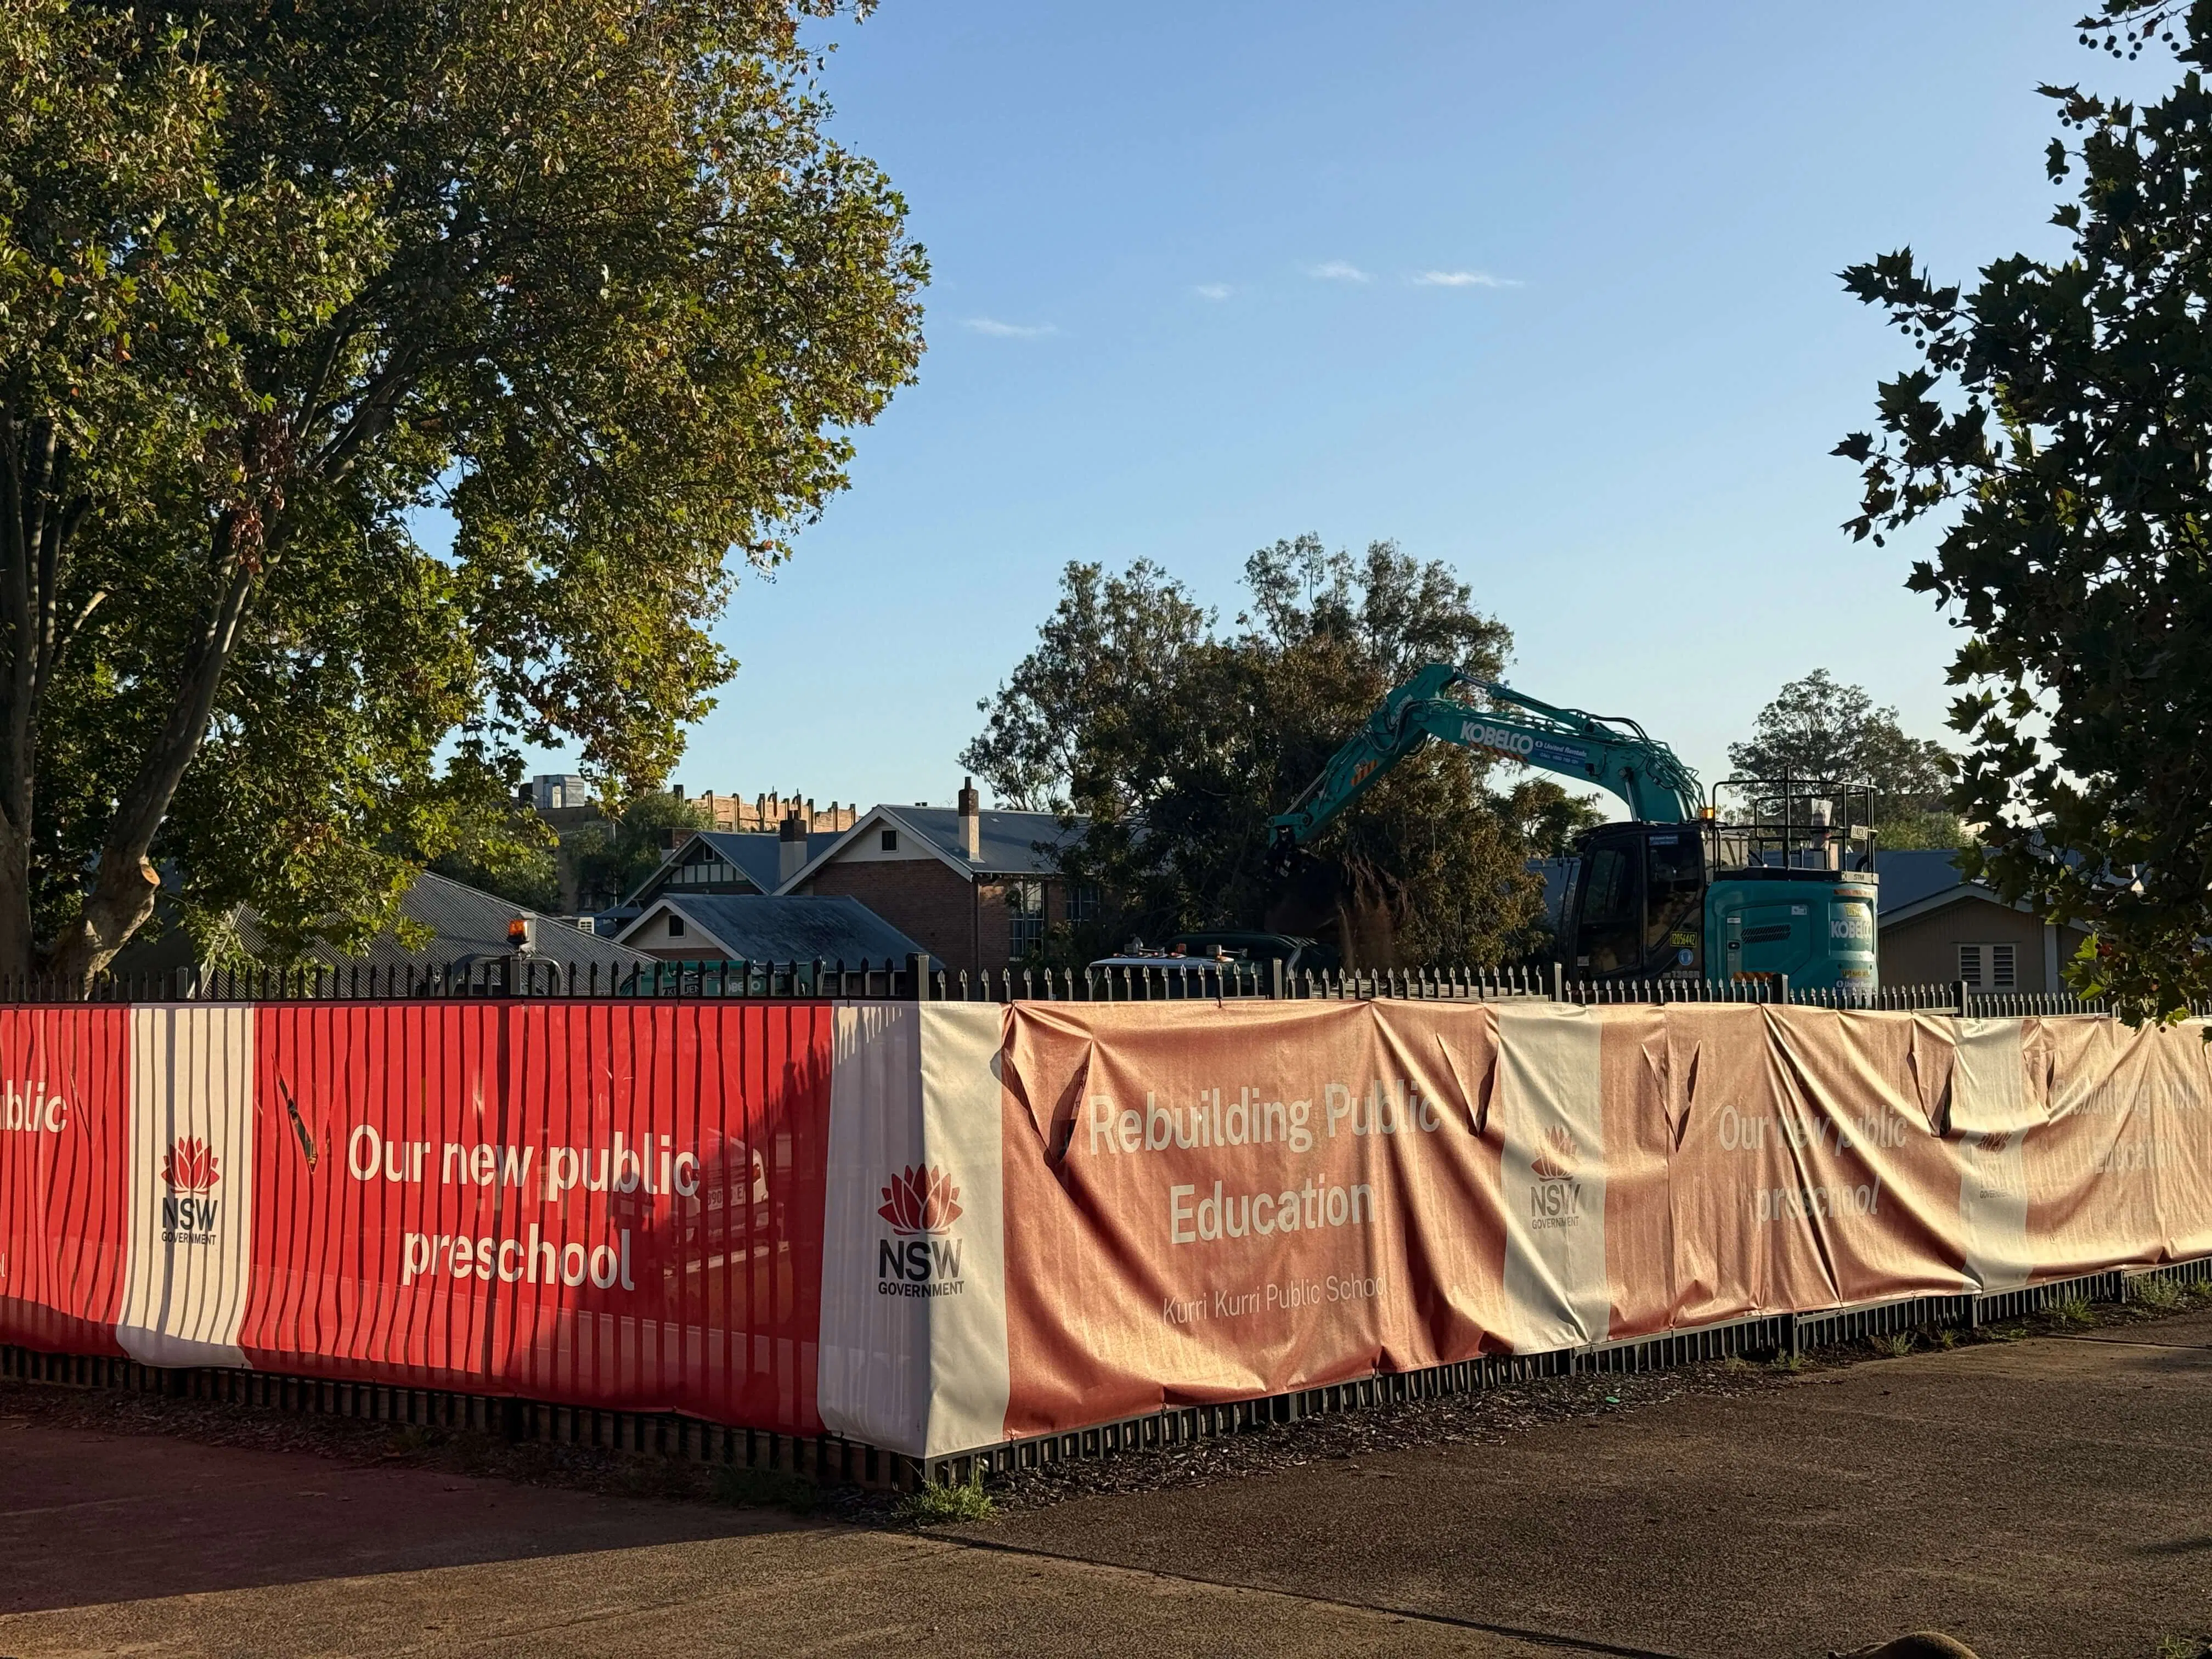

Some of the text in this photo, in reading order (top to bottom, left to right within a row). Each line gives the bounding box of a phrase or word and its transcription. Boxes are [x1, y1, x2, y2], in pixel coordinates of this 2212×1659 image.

[1460, 720, 1533, 755] KOBELCO
[1088, 1086, 1313, 1155] Rebuilding
[1325, 1079, 1440, 1138] Public
[1718, 1104, 1769, 1151] Our
[348, 1124, 701, 1202] Our new public
[162, 1198, 218, 1232] NSW
[1170, 1173, 1374, 1244] Education
[1531, 1183, 1581, 1217] NSW
[161, 1231, 217, 1245] GOVERNMENT
[403, 1223, 634, 1290] preschool
[879, 1239, 962, 1282] NSW
[878, 1280, 964, 1297] GOVERNMENT
[1163, 1270, 1387, 1325] Kurri Kurri Public School
